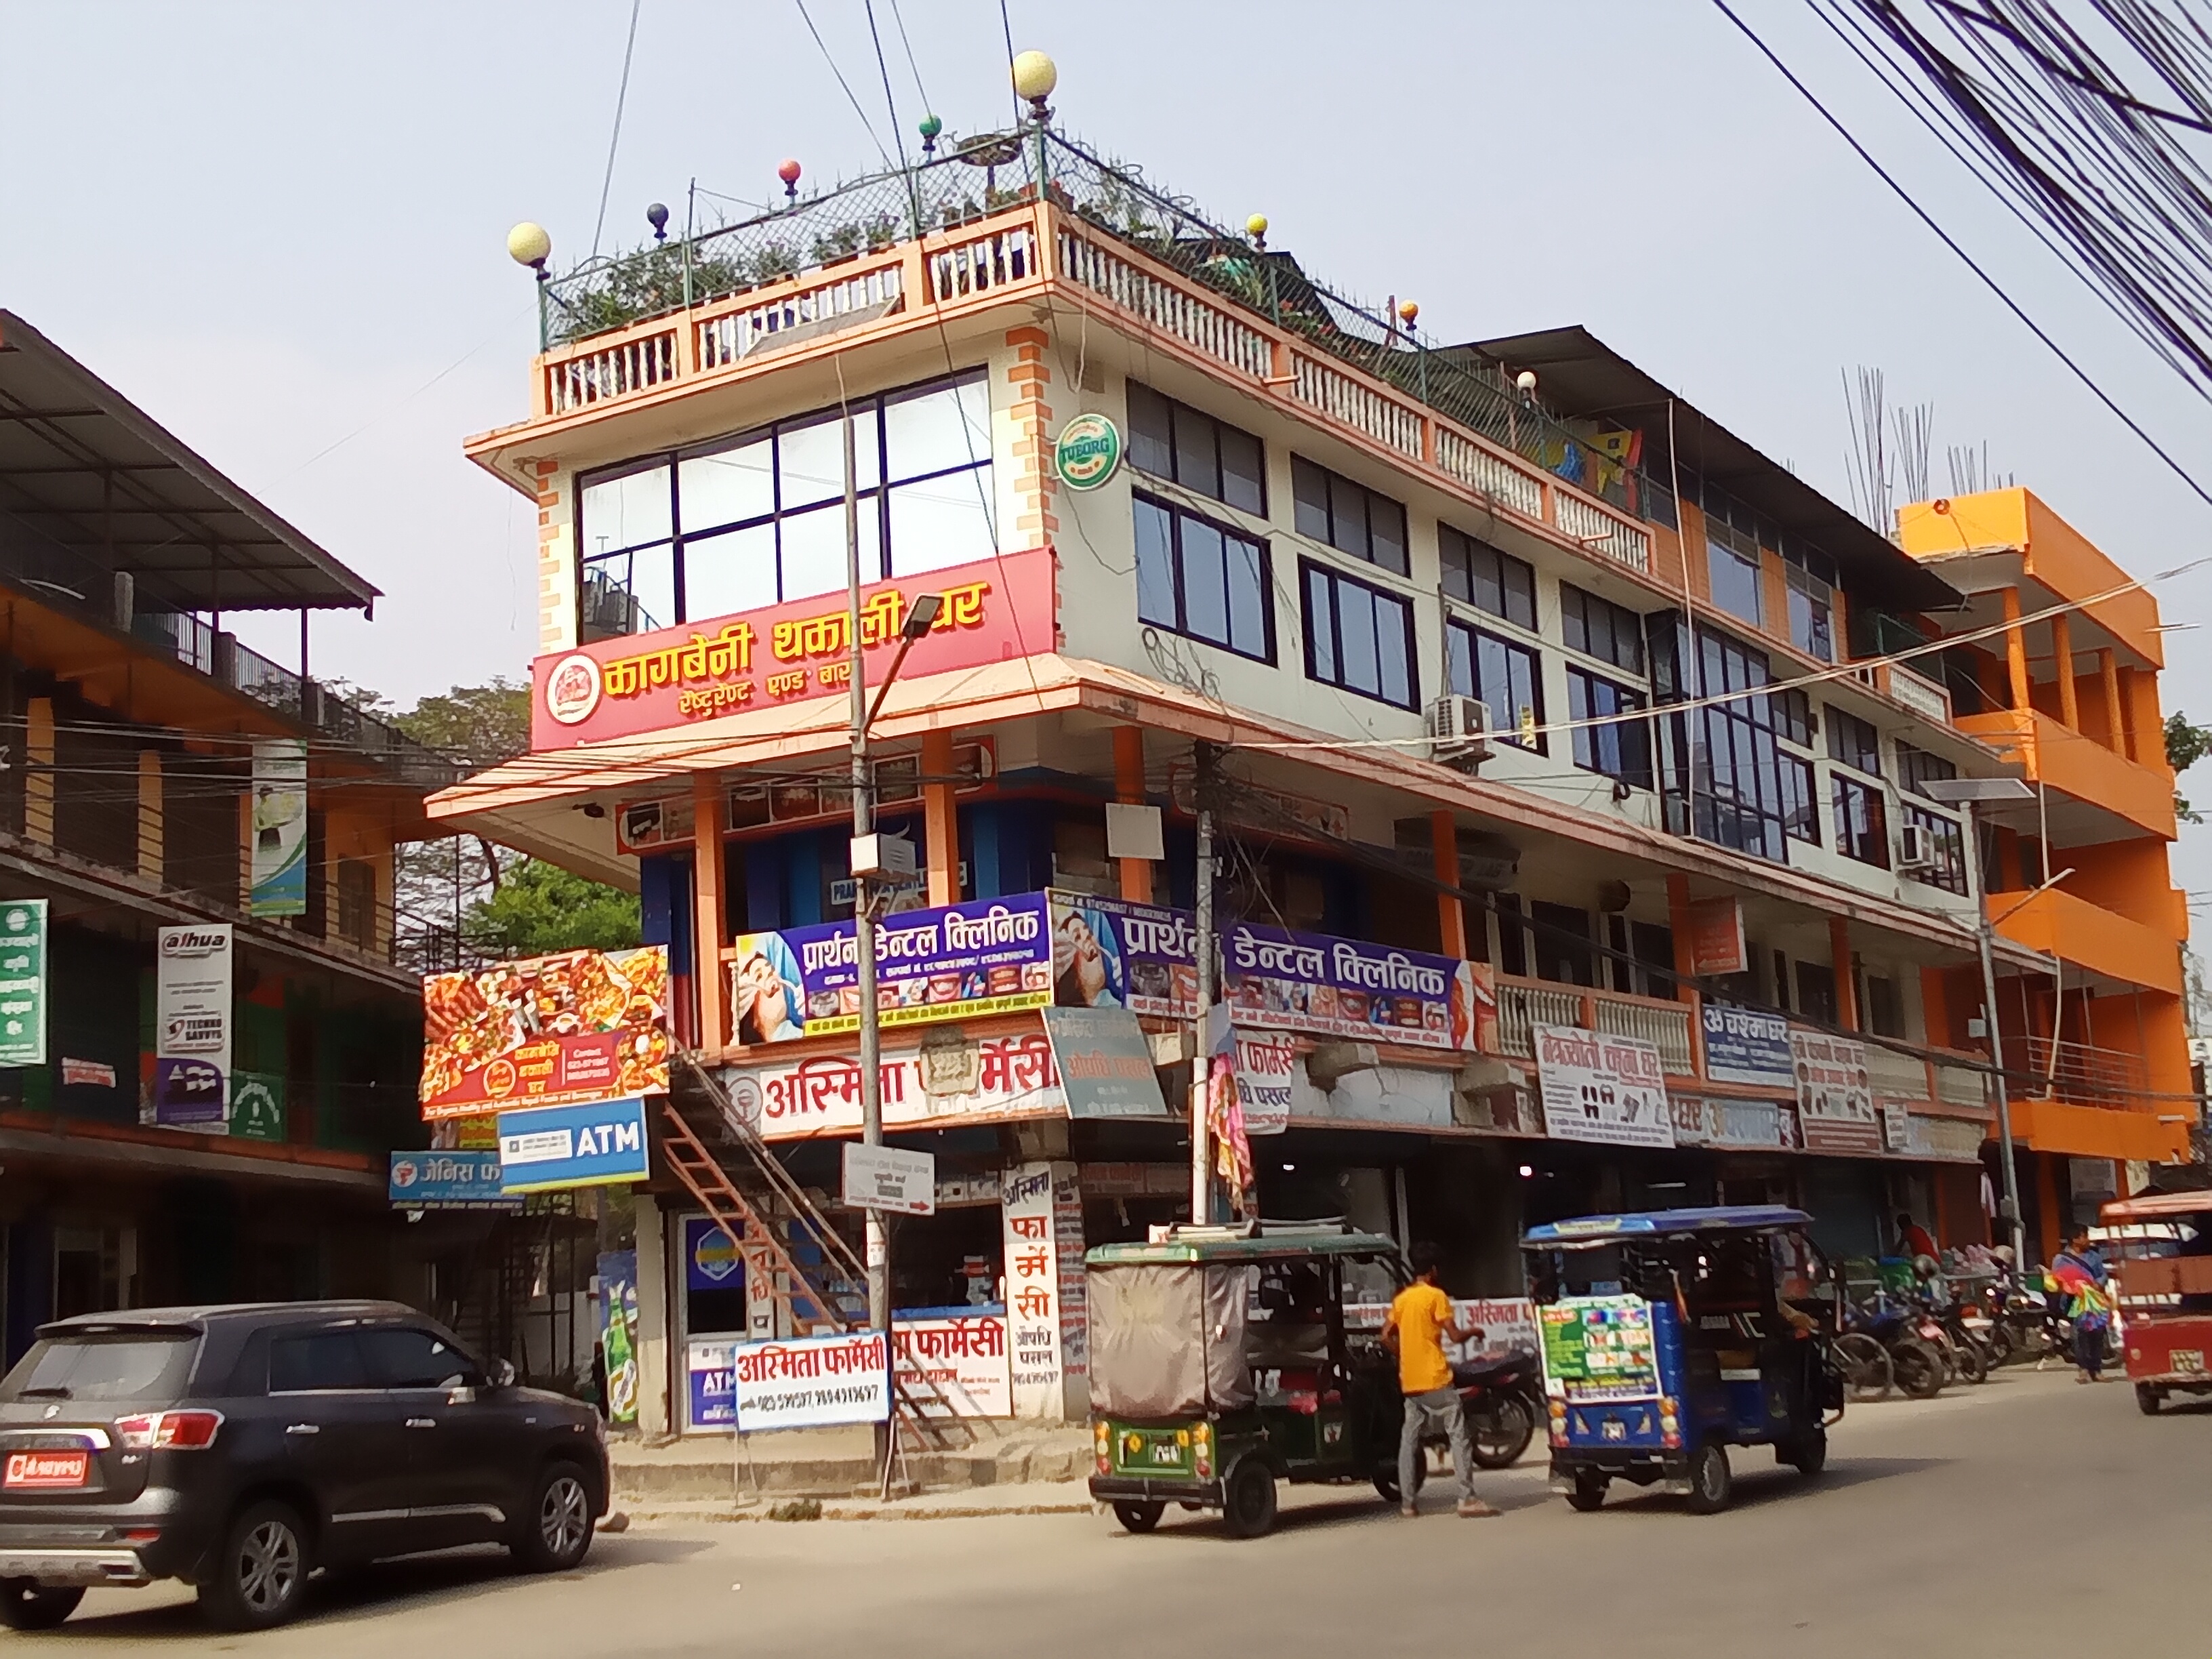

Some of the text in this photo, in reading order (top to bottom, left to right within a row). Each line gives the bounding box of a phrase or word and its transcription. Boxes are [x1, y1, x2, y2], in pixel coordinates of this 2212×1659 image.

[1060, 437, 1110, 464] TUBORG
[604, 622, 756, 696] कागबेनी
[802, 930, 859, 976] प्रार्थन
[945, 904, 1040, 953] क्लिनिक
[1232, 926, 1325, 980] डेन्टल
[1332, 942, 1446, 996] क्लिनिक
[576, 1122, 640, 1158] ATM
[1003, 1170, 1049, 1207] अस्मिता
[737, 1335, 885, 1383] अस्मिता फार्मेसी
[915, 1317, 1004, 1360] फार्मेसी
